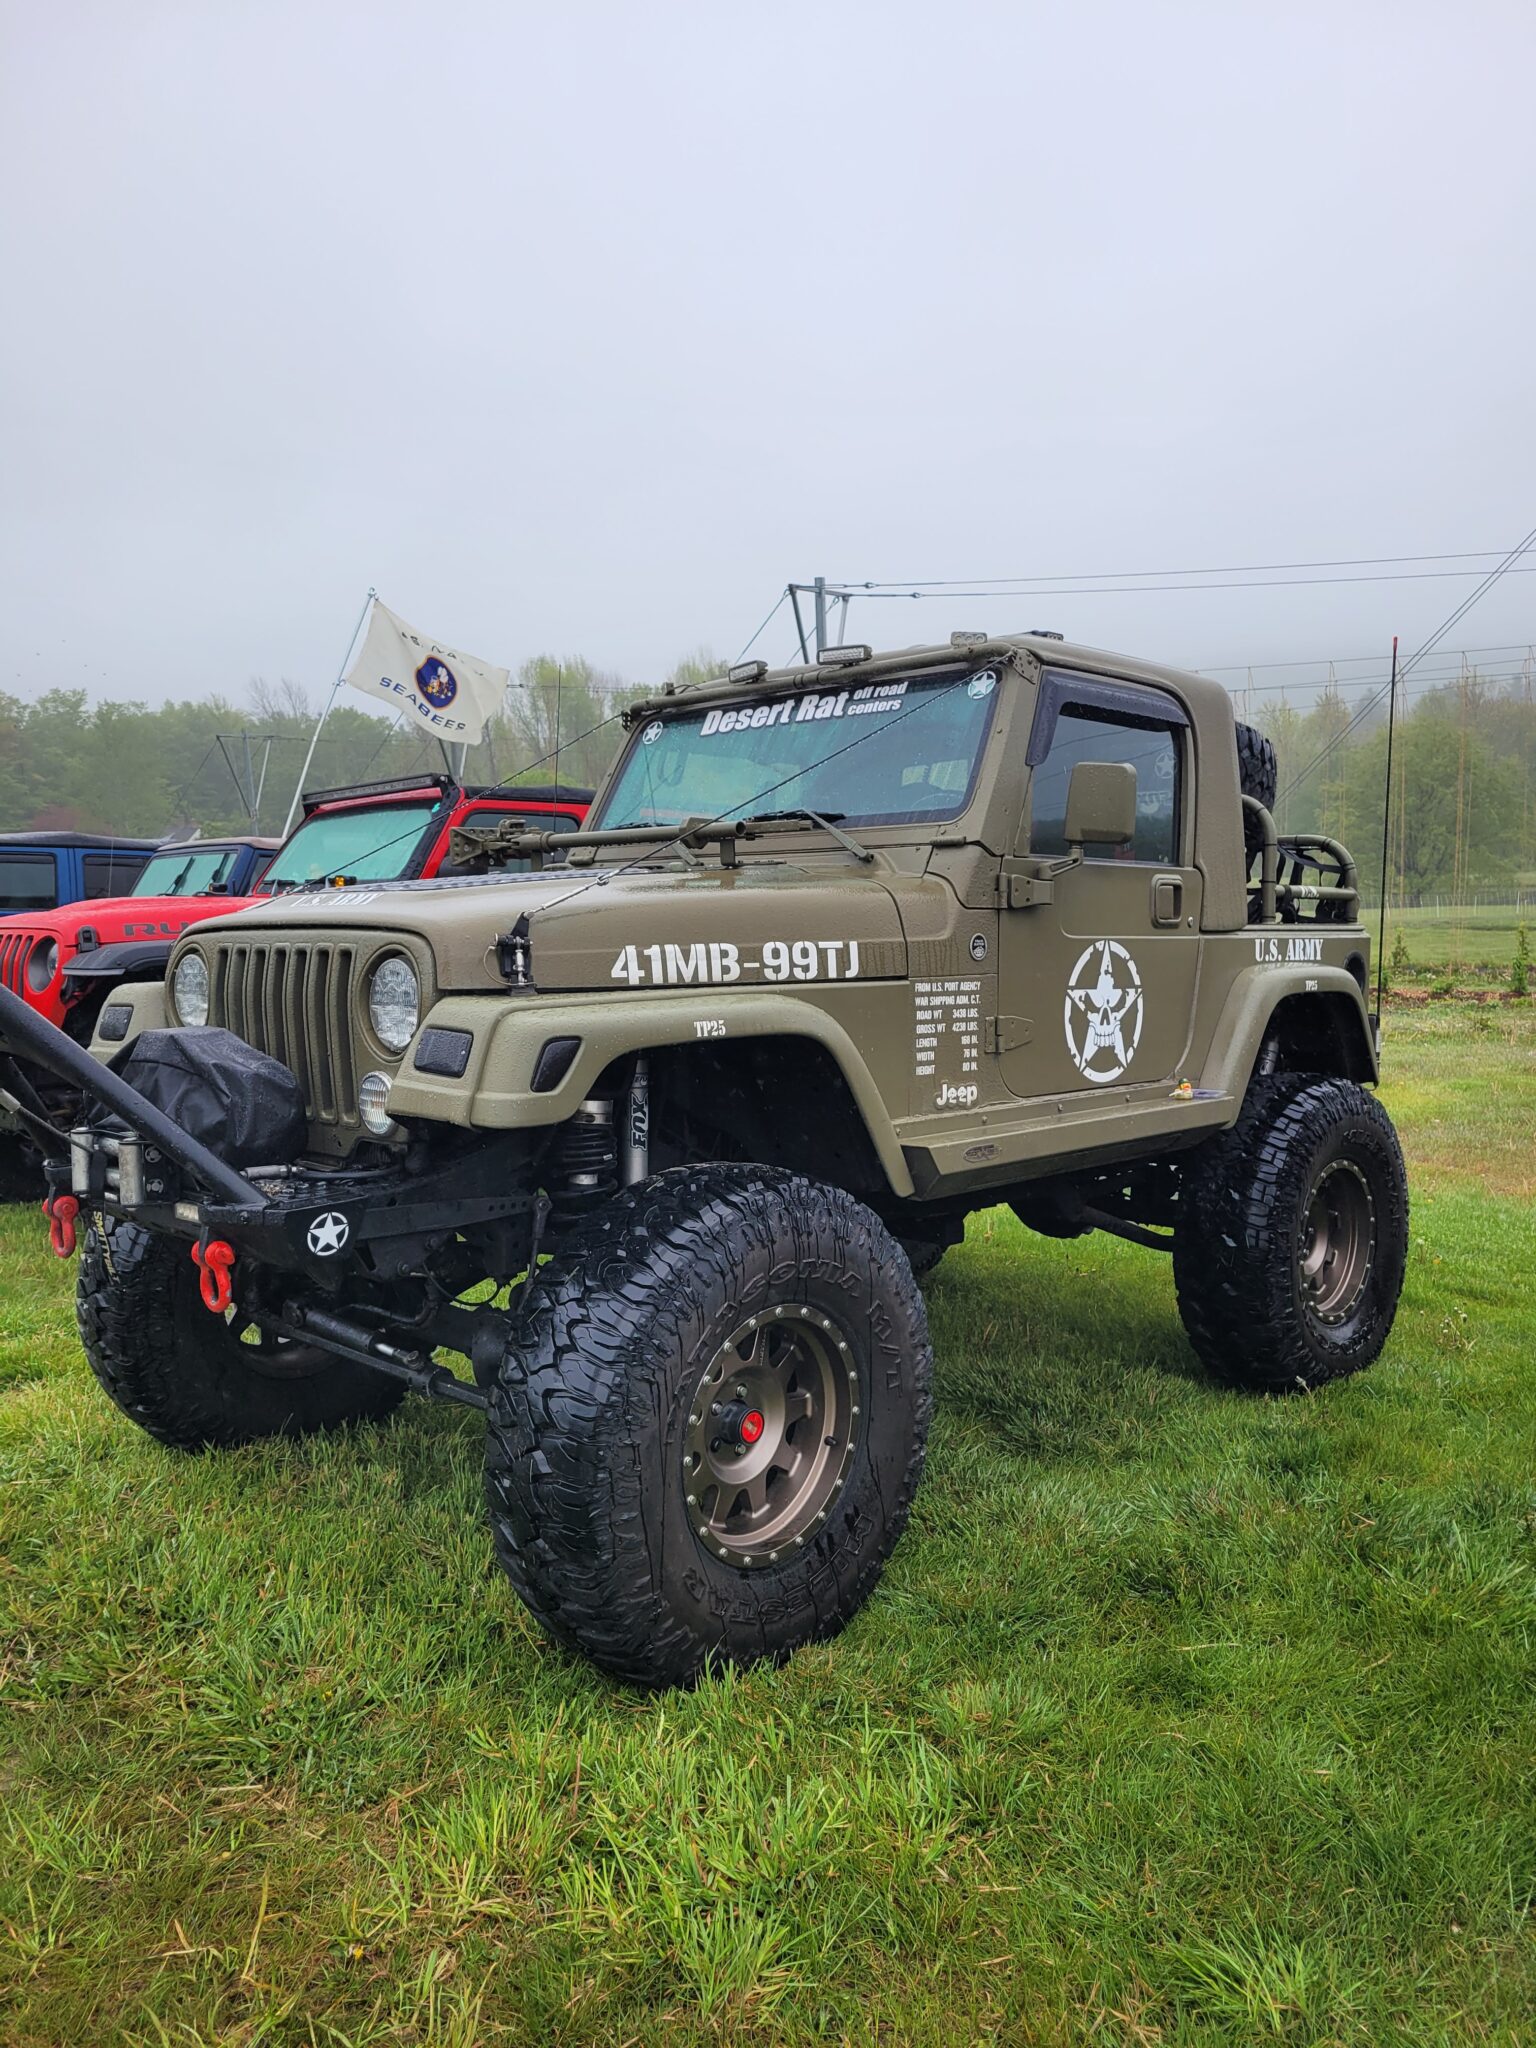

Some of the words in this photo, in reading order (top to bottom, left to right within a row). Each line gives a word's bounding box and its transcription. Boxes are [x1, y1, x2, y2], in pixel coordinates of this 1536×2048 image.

[379, 676, 466, 731] SEABEES
[699, 698, 794, 738] Desert
[795, 691, 849, 723] Rat
[853, 687, 872, 701] off
[873, 681, 909, 697] road
[846, 698, 902, 716] centers
[1255, 939, 1282, 962] U.S.
[1285, 939, 1324, 962] ARMY
[611, 941, 860, 985] 41MB-99TJ
[915, 982, 931, 993] FROM
[932, 982, 943, 992] U.S.
[944, 982, 959, 992] PORT
[960, 981, 981, 991] AGENCY
[915, 996, 929, 1007] WAR
[929, 995, 954, 1006] SHIPPING
[916, 1010, 932, 1020] ROAD
[933, 1009, 943, 1020] WT
[968, 1008, 979, 1018] LBS.
[693, 1020, 726, 1038] TP25
[916, 1024, 935, 1034] GROSS
[937, 1023, 946, 1033] WT
[967, 1021, 979, 1031] LBS.
[916, 1037, 938, 1048] LENGTH
[916, 1051, 935, 1061] WIDTH
[915, 1065, 936, 1076] HEIGHT
[936, 1083, 978, 1107] Jeep
[630, 1092, 648, 1152] FOX
[92, 1210, 121, 1284] SMITTYBILT
[866, 1299, 903, 1398] M/T
[682, 1513, 873, 1626] MILESTAR
